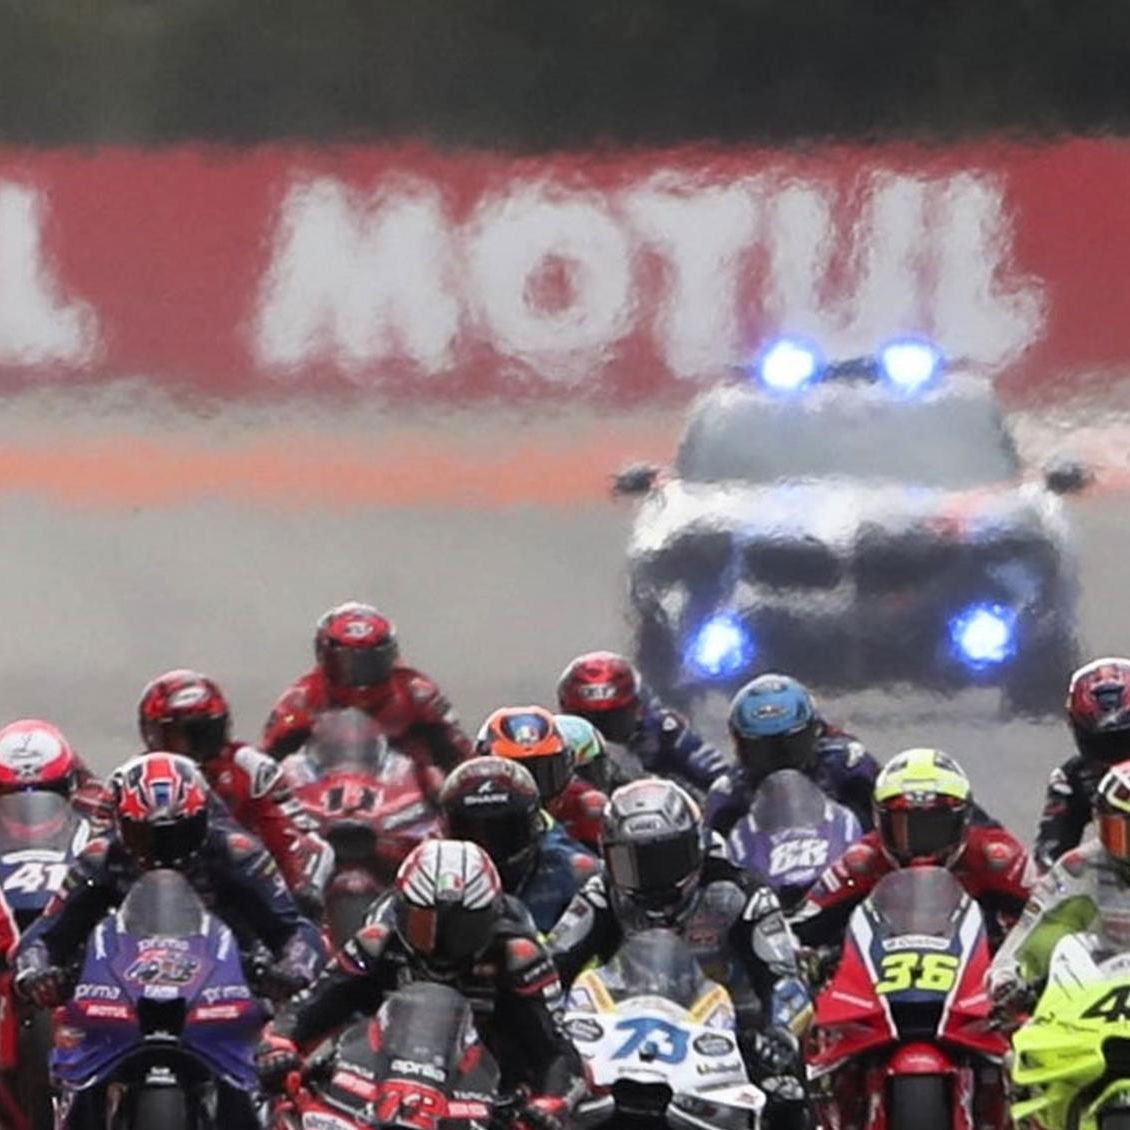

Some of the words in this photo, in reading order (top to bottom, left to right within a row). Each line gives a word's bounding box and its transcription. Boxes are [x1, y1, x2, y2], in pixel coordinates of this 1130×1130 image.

[252, 168, 1046, 378] MOTUL
[3, 863, 69, 893] 41
[875, 952, 959, 994] 36
[74, 984, 121, 1001] prima
[611, 1018, 691, 1064] 73
[390, 1059, 447, 1083] aprilia
